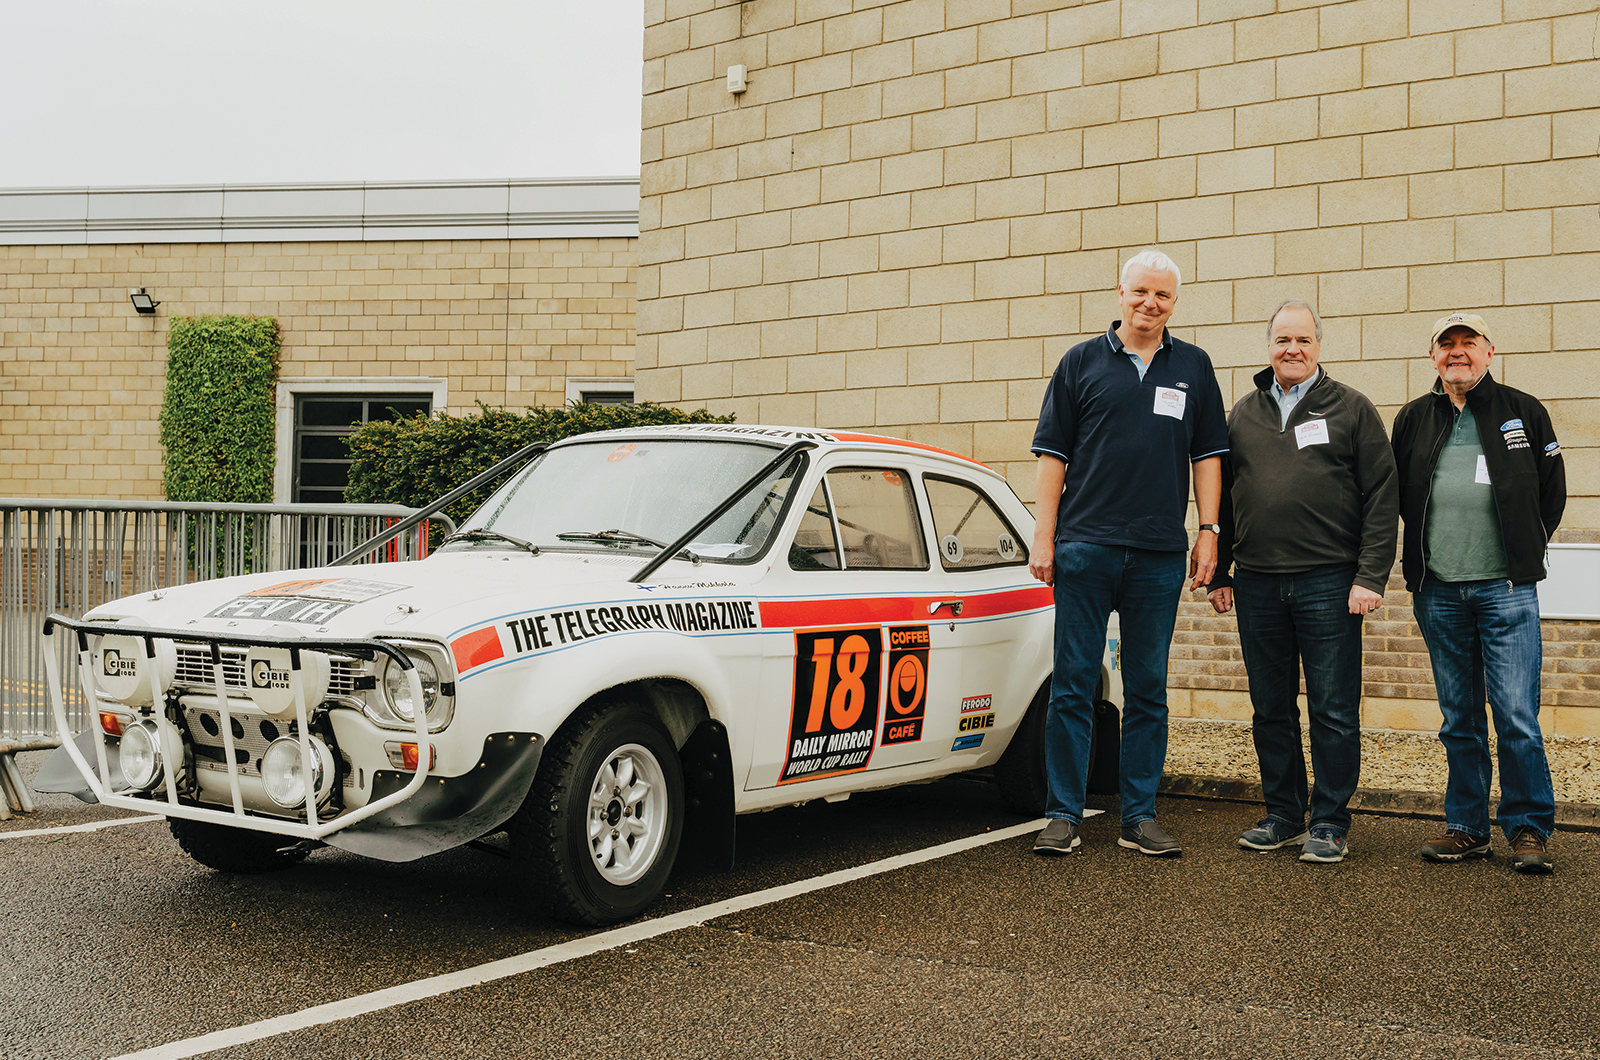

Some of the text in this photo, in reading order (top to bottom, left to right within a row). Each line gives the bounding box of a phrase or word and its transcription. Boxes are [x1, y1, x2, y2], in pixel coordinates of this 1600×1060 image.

[700, 426, 835, 442] MAGAZINE
[947, 541, 958, 556] 69
[1000, 539, 1014, 553] 104
[506, 601, 757, 653] THE TELEGRAPH MAGAZINE
[891, 631, 929, 645] COFFEE
[805, 634, 871, 733] 18
[962, 697, 991, 711] FERODO
[889, 723, 916, 740] CAFÉ
[792, 729, 874, 759] DAILY MIRROR
[786, 750, 870, 776] WORLD CUP RALLY
